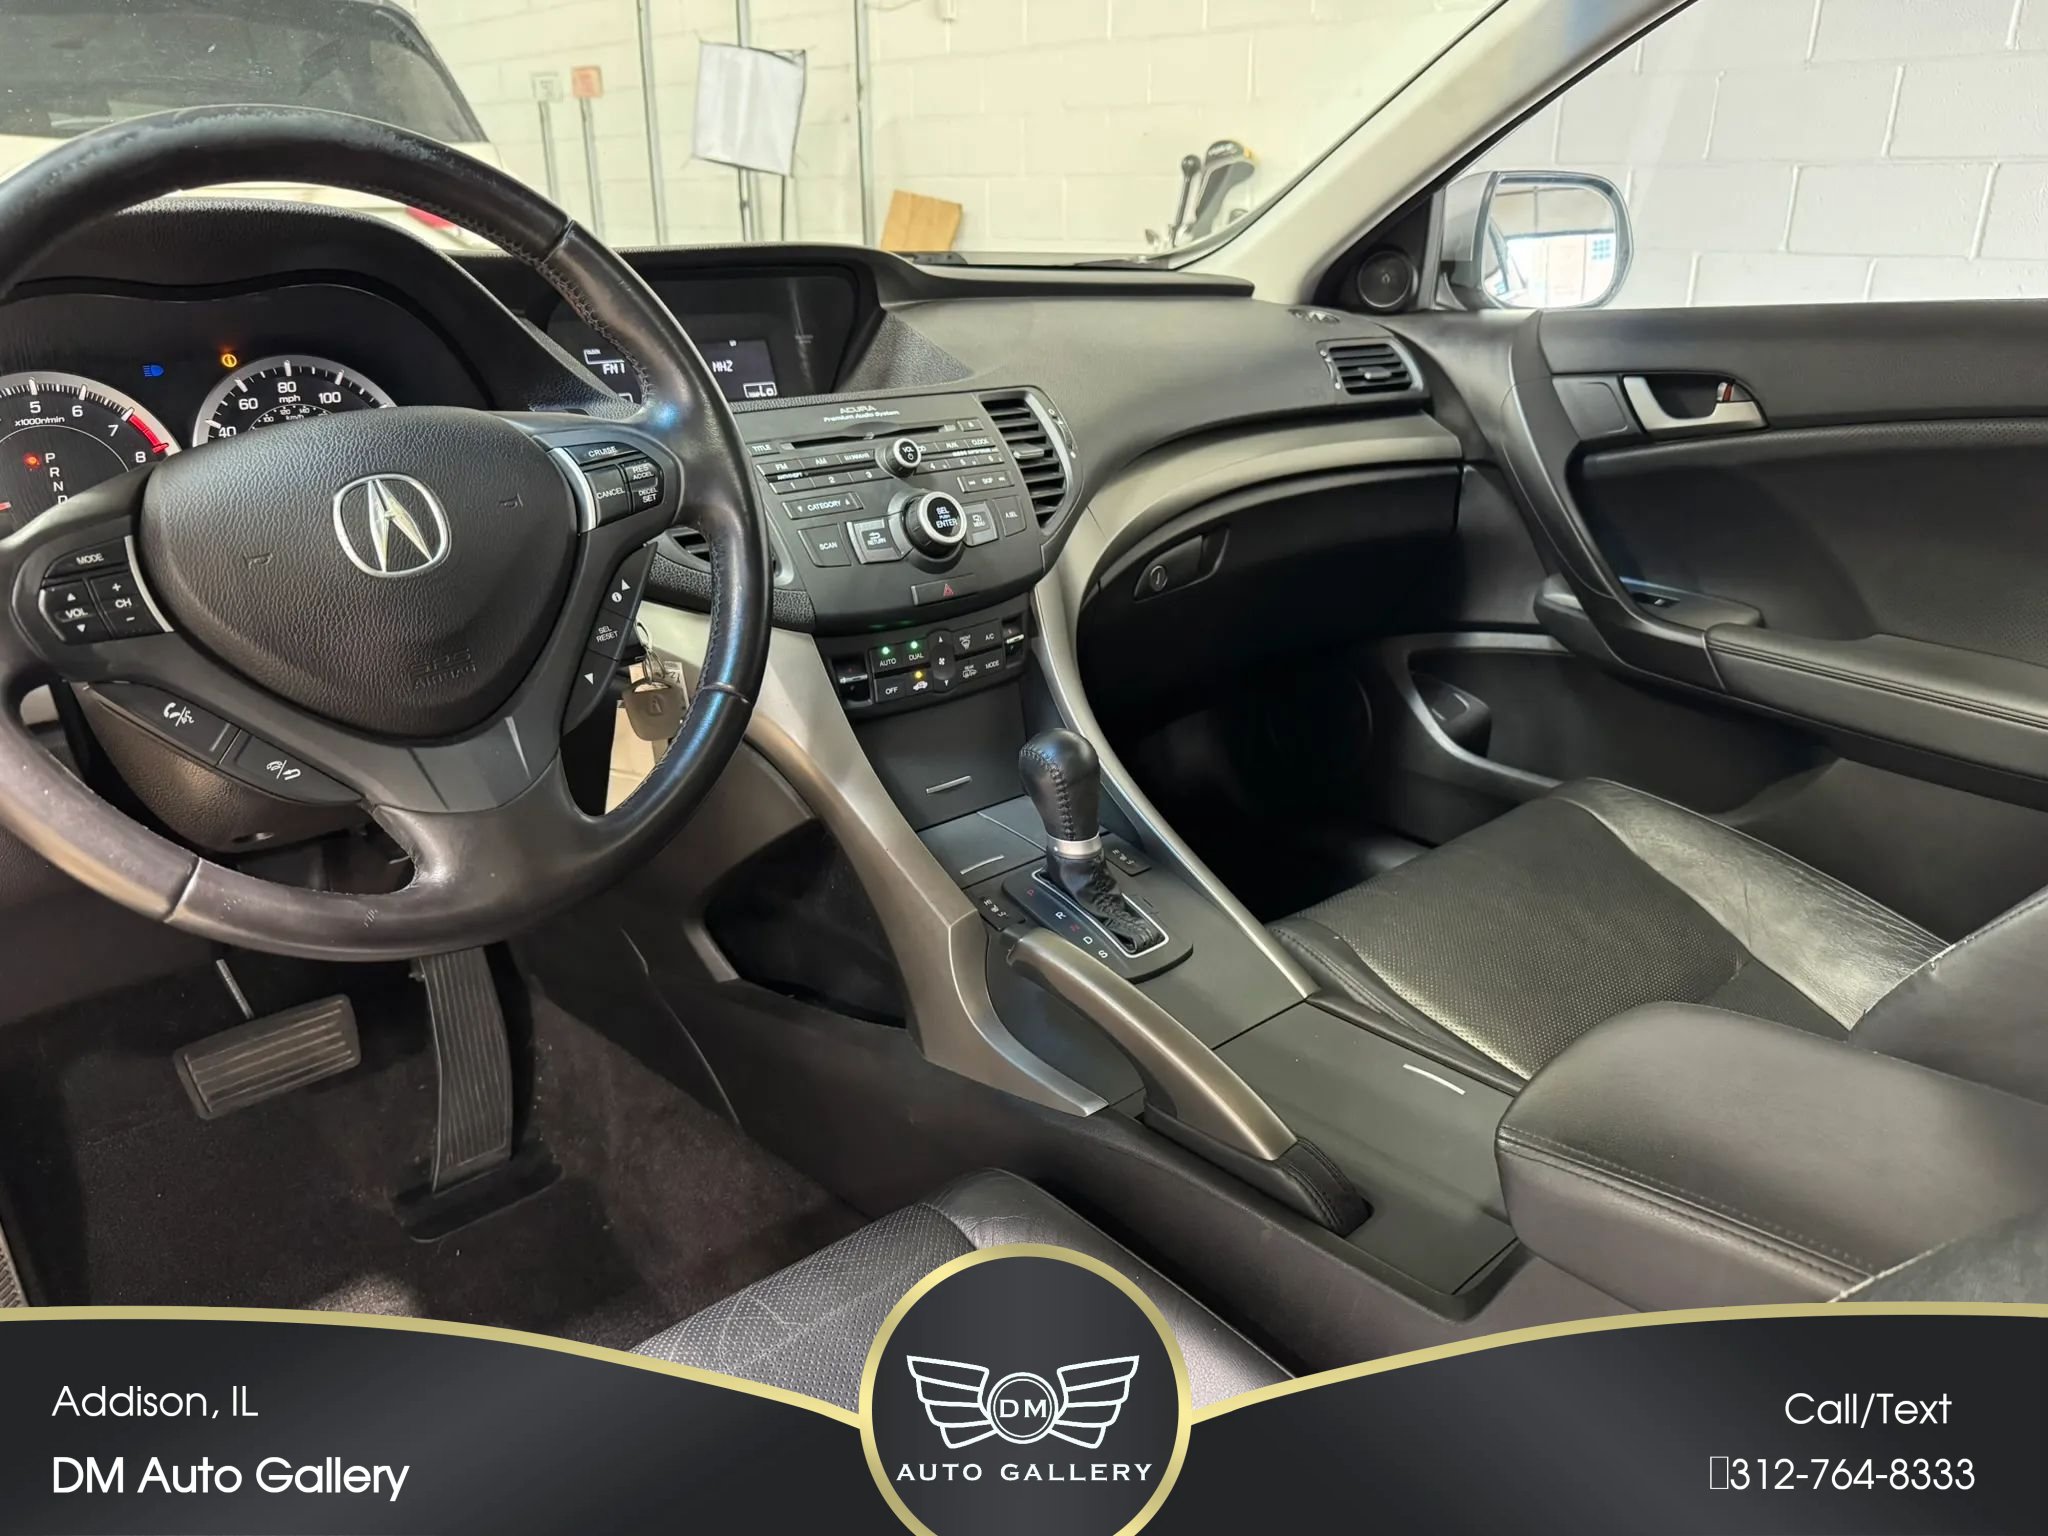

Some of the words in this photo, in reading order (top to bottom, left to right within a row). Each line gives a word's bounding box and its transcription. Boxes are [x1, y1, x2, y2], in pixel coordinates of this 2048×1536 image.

[277, 381, 297, 393] 80
[279, 395, 300, 404] mph
[318, 392, 341, 404] 100
[29, 401, 41, 413] 5
[238, 398, 258, 410] 60
[71, 405, 84, 417] 6
[108, 424, 119, 437] 7
[218, 426, 237, 438] 40
[588, 446, 617, 458] CRUISE
[751, 443, 773, 452] TITLE
[45, 452, 56, 463] P
[135, 451, 147, 463] 8
[815, 457, 828, 465] AM
[632, 465, 649, 474] RES
[775, 463, 788, 471] FM
[49, 467, 60, 478] R
[633, 471, 654, 480] ACCEL
[865, 471, 872, 479] 3
[828, 476, 836, 484] 2
[53, 481, 64, 492] N
[638, 487, 659, 496] DECEL
[596, 487, 626, 500] CANCEL
[642, 493, 657, 504] SET
[807, 499, 841, 512] CATEGORY
[936, 506, 950, 515] SEL
[936, 518, 957, 529] ENTER
[819, 541, 838, 551] SCAN
[867, 537, 887, 546] RETURN
[76, 552, 104, 565] MODE
[115, 598, 132, 609] CH
[65, 607, 88, 619] VOL
[598, 625, 613, 634] SEL
[596, 630, 619, 643] RESET
[908, 653, 924, 661] DUAL
[879, 658, 897, 667] AUTO
[985, 660, 1000, 669] MODE
[885, 686, 898, 695] OFF
[1055, 911, 1066, 920] R
[1082, 935, 1093, 945] D
[1098, 950, 1108, 959] S
